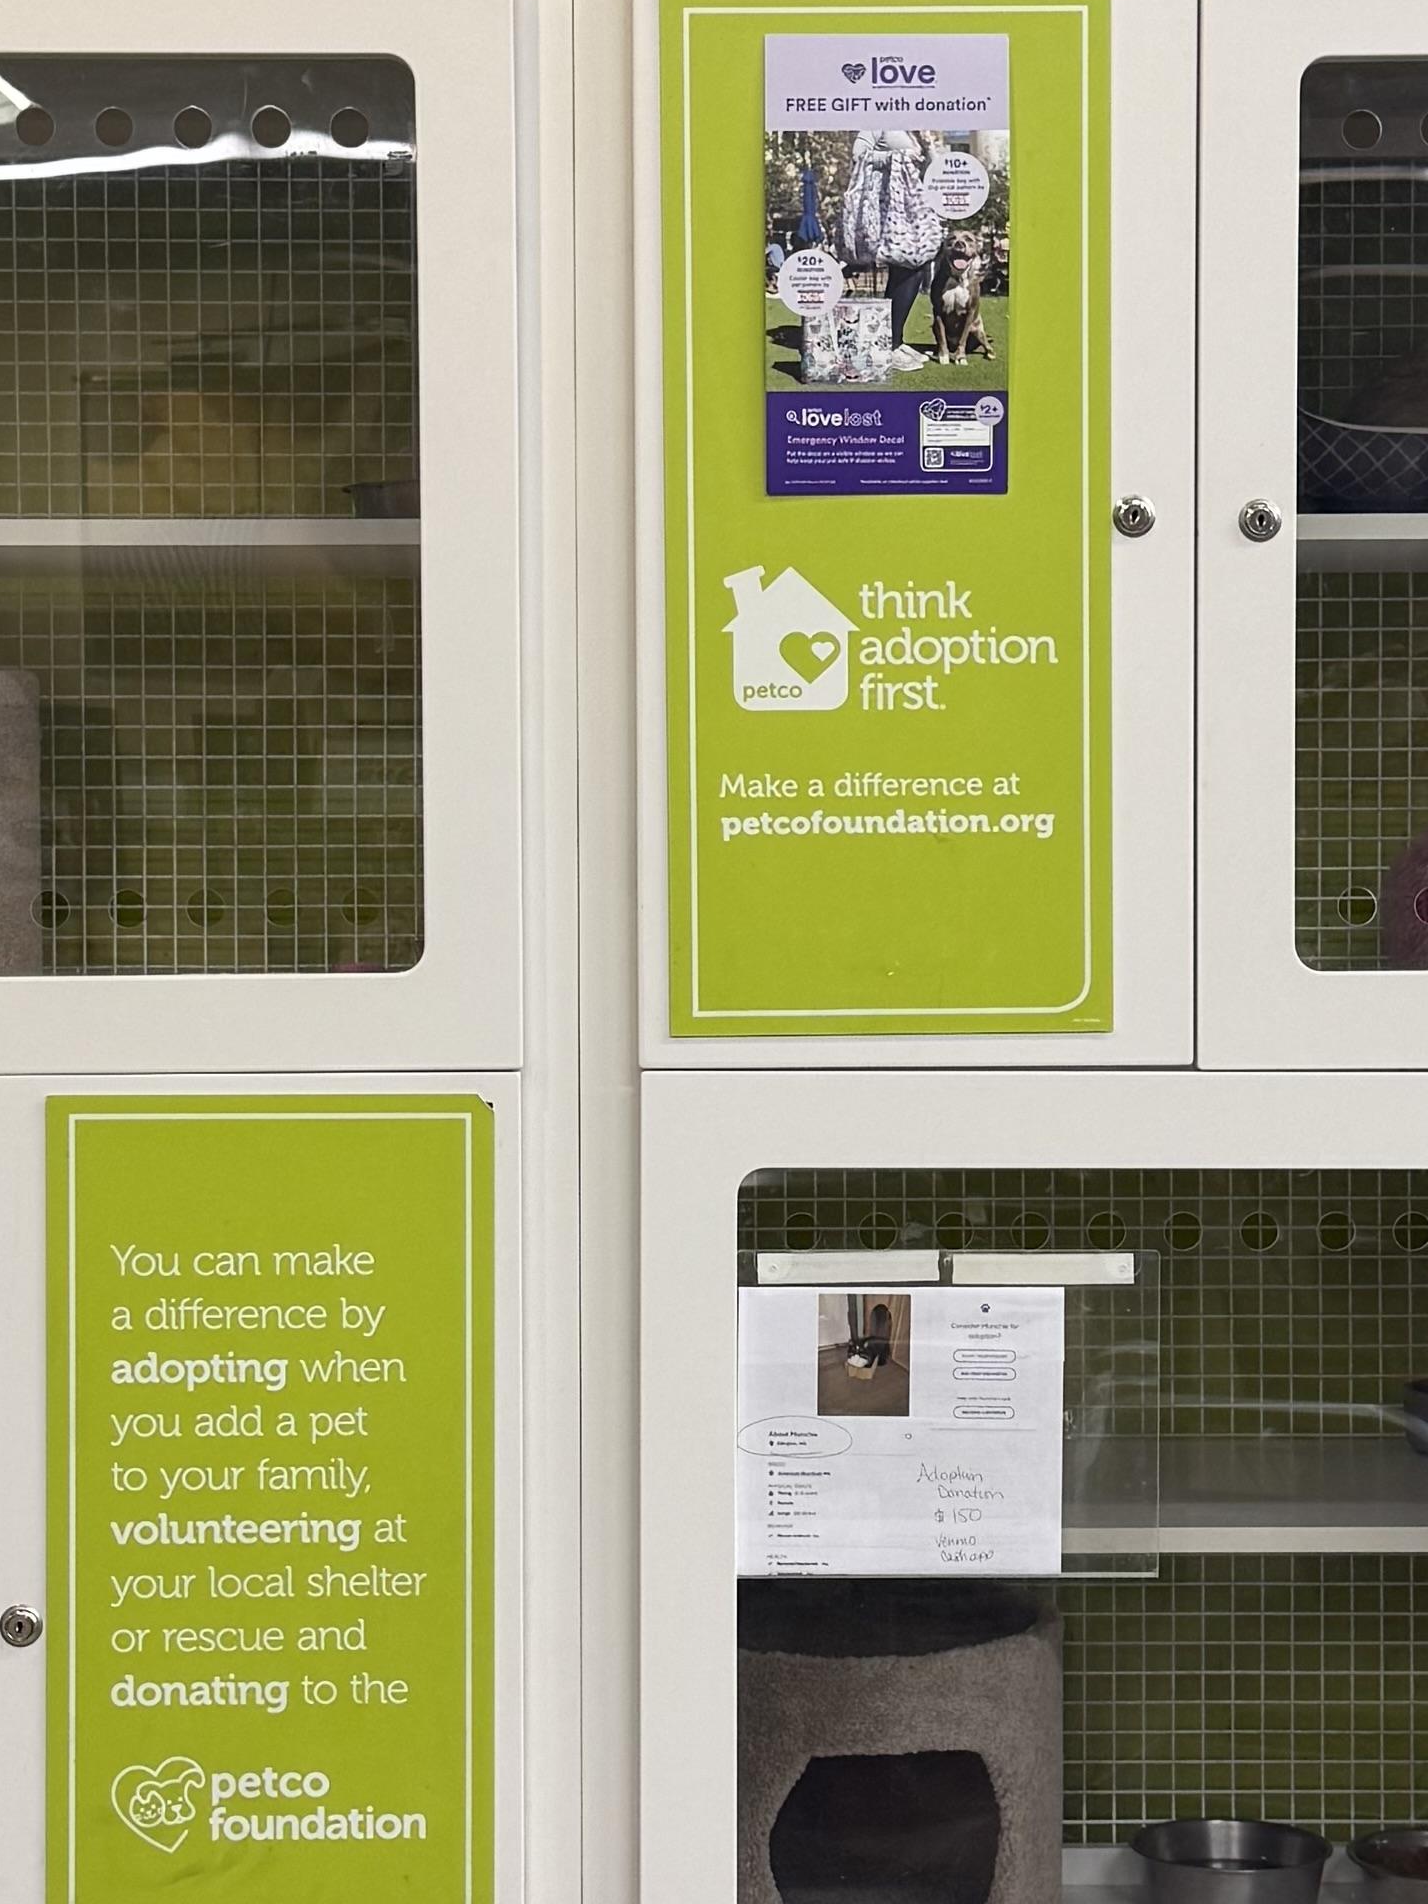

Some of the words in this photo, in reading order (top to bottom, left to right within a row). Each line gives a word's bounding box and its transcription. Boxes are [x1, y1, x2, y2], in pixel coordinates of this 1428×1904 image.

[871, 56, 936, 84] love
[785, 98, 827, 112] FREE
[831, 98, 871, 112] GIFT
[875, 97, 910, 112] with
[787, 435, 838, 446] Emergency
[839, 435, 877, 444] Window
[879, 435, 905, 444] Decal
[858, 580, 973, 620] think
[858, 626, 1060, 675] adoption
[742, 682, 803, 703] petco
[859, 672, 947, 711] first.
[718, 772, 799, 799] Make
[807, 778, 825, 798] a
[834, 771, 984, 798] difference
[992, 772, 1021, 796] at
[720, 808, 1055, 842] petcofoundation.org
[109, 1243, 182, 1277] You
[192, 1250, 262, 1277] can
[273, 1243, 375, 1277] make
[110, 1305, 133, 1331] a
[145, 1297, 328, 1331] difference
[340, 1297, 387, 1337] by
[110, 1351, 289, 1392] adopting
[300, 1350, 407, 1383] when
[109, 1413, 183, 1447] you
[194, 1404, 264, 1438] add
[275, 1412, 298, 1437] a
[309, 1406, 369, 1445] pet
[110, 1461, 148, 1492] to
[159, 1466, 246, 1500] your
[257, 1458, 372, 1498] family,
[109, 1511, 363, 1552] volunteering
[374, 1514, 408, 1544] at
[110, 1574, 197, 1608] your
[207, 1565, 295, 1599] local
[306, 1565, 428, 1597] shelter
[110, 1628, 151, 1653] or
[162, 1627, 285, 1653] rescue
[297, 1618, 368, 1652] and
[110, 1673, 290, 1714] donating
[300, 1676, 338, 1705] to
[350, 1672, 409, 1705] the
[210, 1767, 331, 1806] petco
[209, 1806, 428, 1842] foundation
